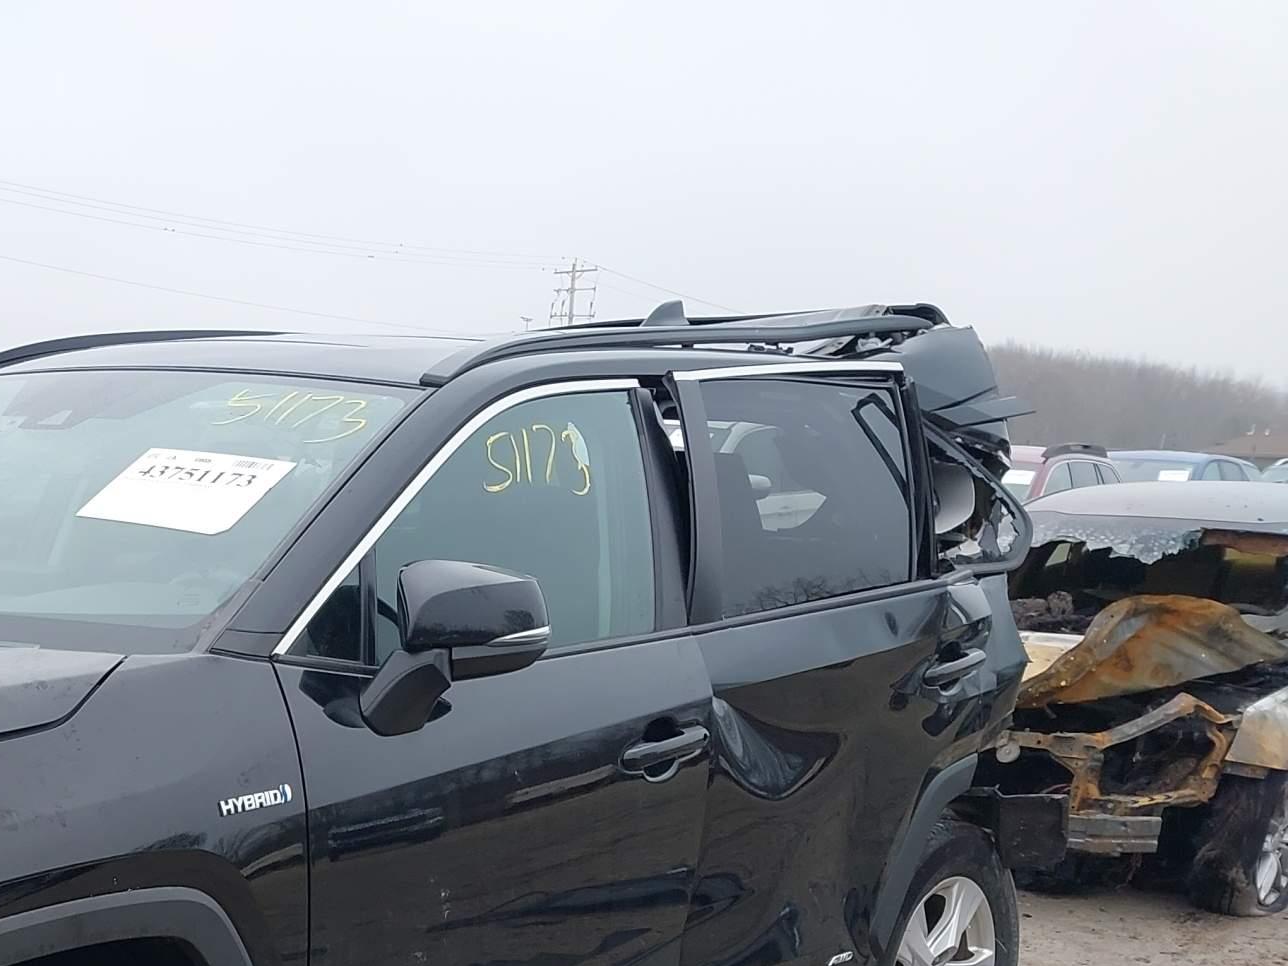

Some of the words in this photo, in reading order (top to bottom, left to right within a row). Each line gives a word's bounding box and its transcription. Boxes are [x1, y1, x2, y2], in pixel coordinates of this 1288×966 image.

[211, 389, 367, 444] 51173
[137, 464, 258, 488] 43751173
[482, 422, 590, 496] 51173
[218, 789, 283, 816] HYBRID
